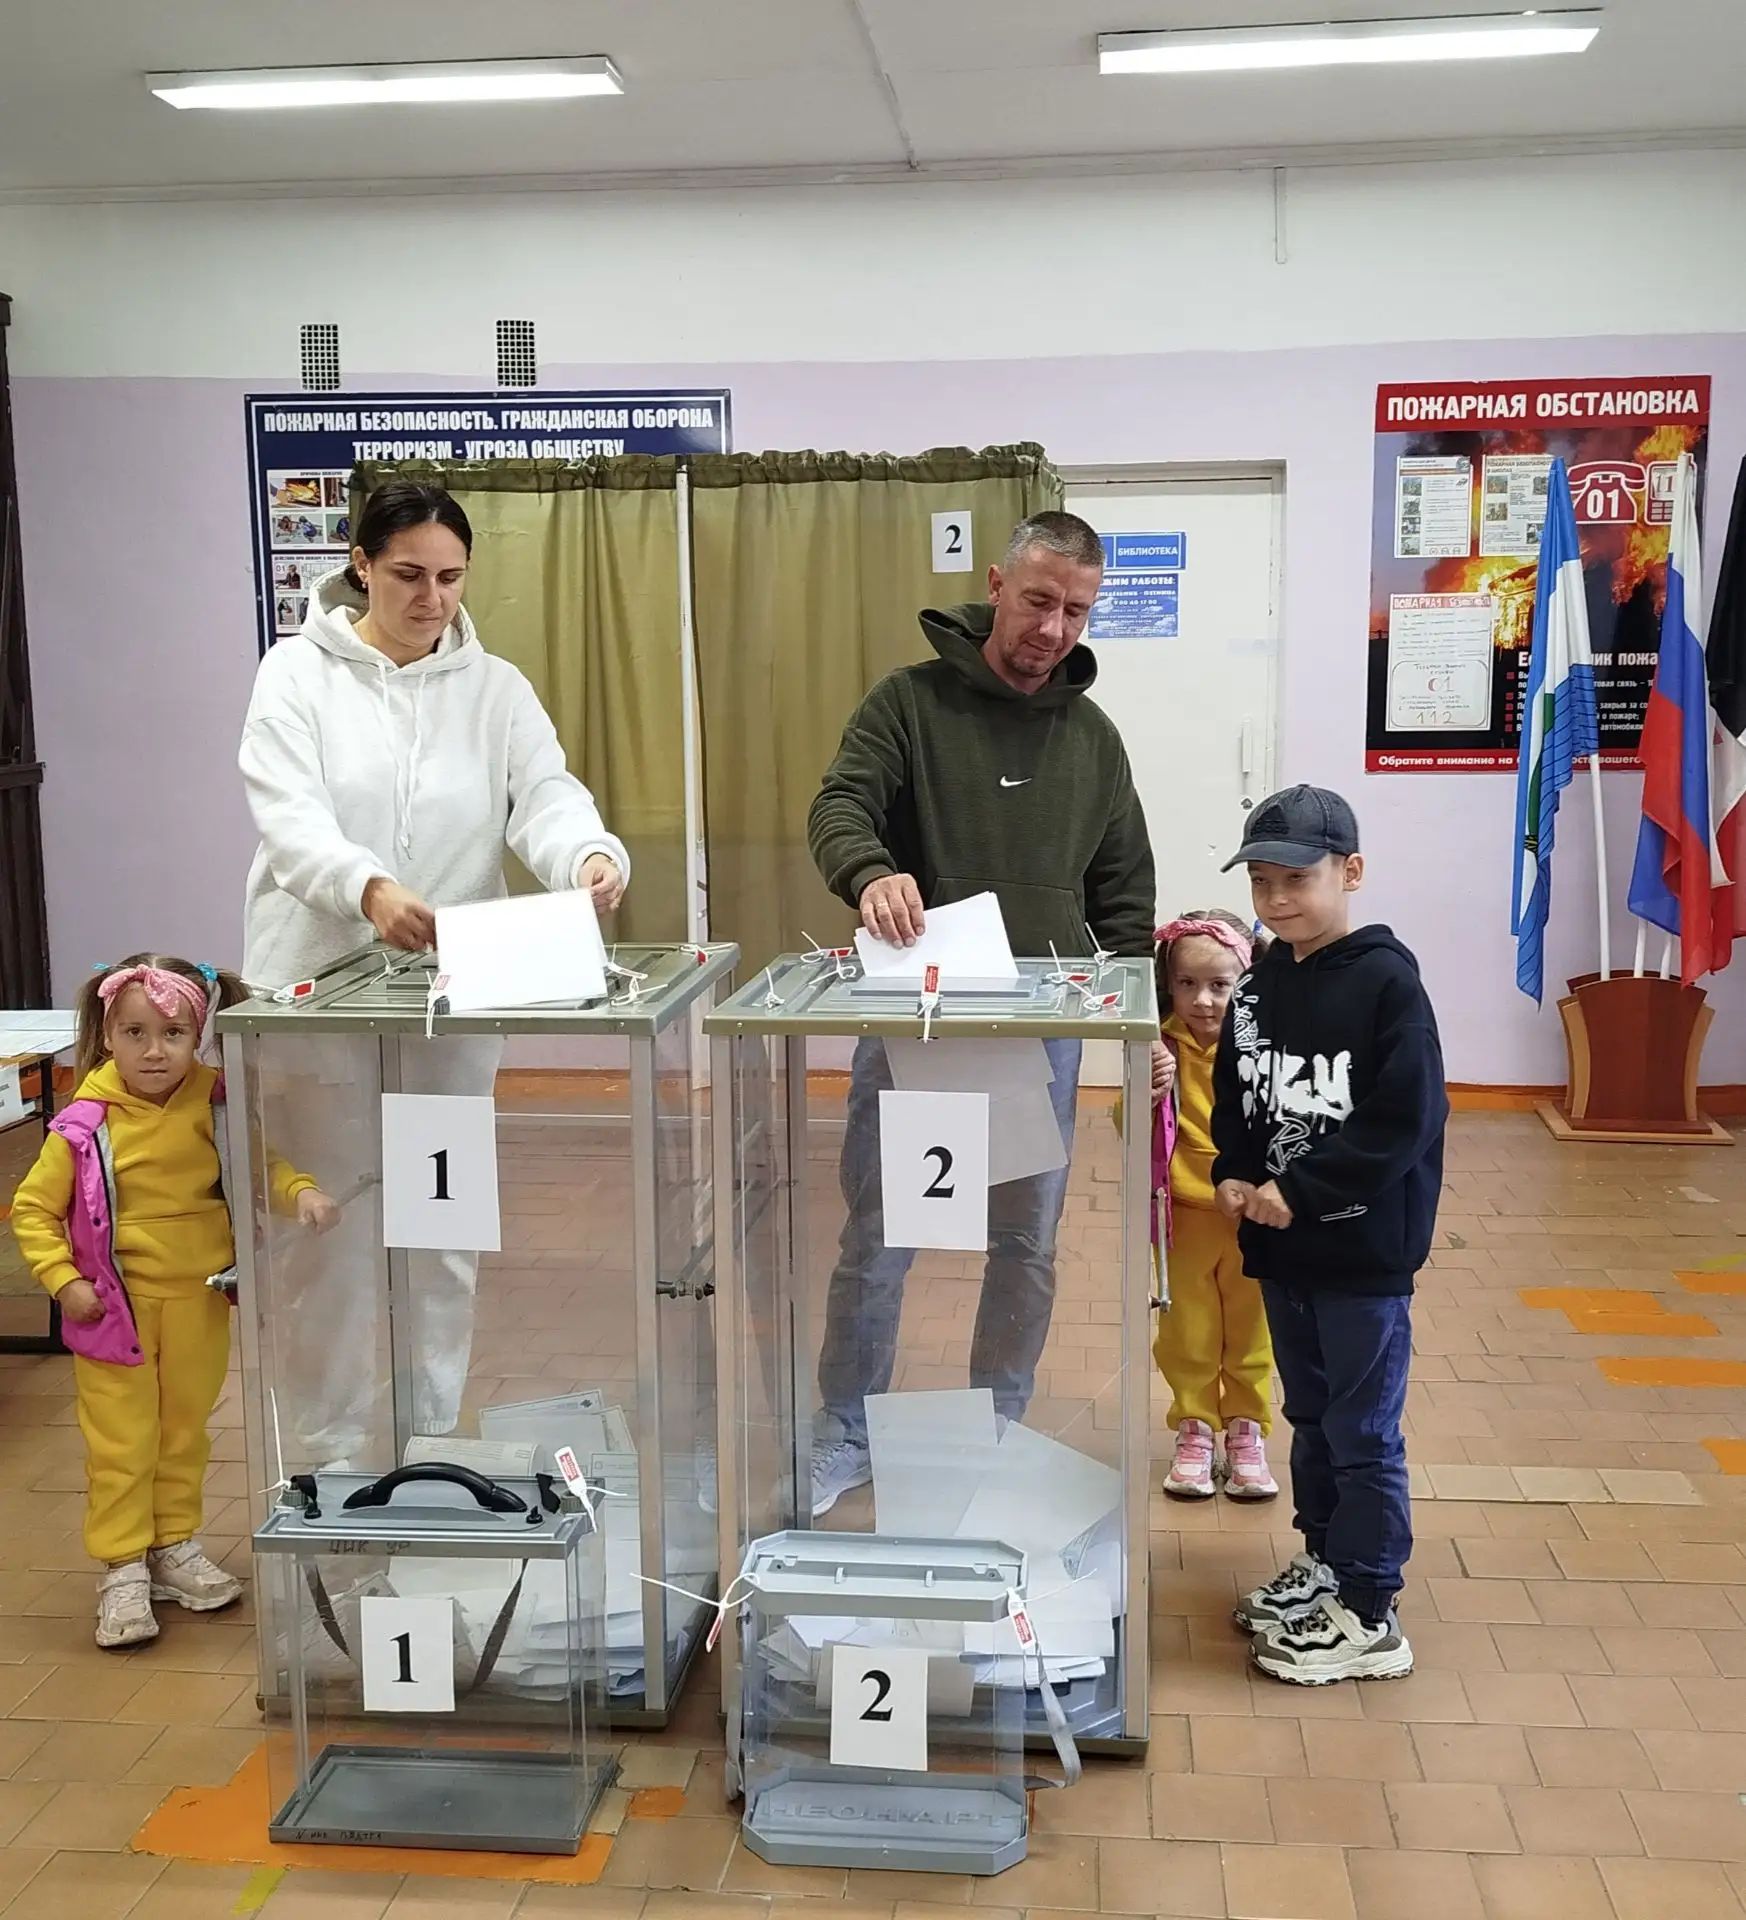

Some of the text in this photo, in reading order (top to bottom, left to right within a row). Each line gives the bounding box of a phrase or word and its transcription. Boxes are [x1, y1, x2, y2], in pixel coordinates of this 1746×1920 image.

[1387, 389, 1700, 421] ПОЖАРНАЯ ОБСТАНОВКА
[264, 408, 714, 432] ПОЖАРНАЯ БЕЗОПАСНОСТЬ. ГРАЖДАНСКАЯ ОБОРОНА
[352, 441, 450, 461] ТЕРРОРИЗМ
[465, 440, 529, 460] УГРОЗА
[531, 439, 625, 460] ОБЩЕСТВУ
[1586, 488, 1620, 519] 01
[944, 524, 963, 554] 2
[1117, 547, 1178, 556] БИБЛИОТЕКА
[1103, 577, 1129, 586] ЖИМ
[1617, 652, 1659, 666] пожа
[1416, 711, 1456, 725] 112
[1378, 756, 1433, 768] Обратите
[1436, 757, 1495, 765] внимание
[1498, 757, 1514, 765] на
[427, 1148, 456, 1200] 1
[922, 1145, 955, 1199] 2
[389, 1631, 419, 1683] 1
[859, 1669, 894, 1722] 2
